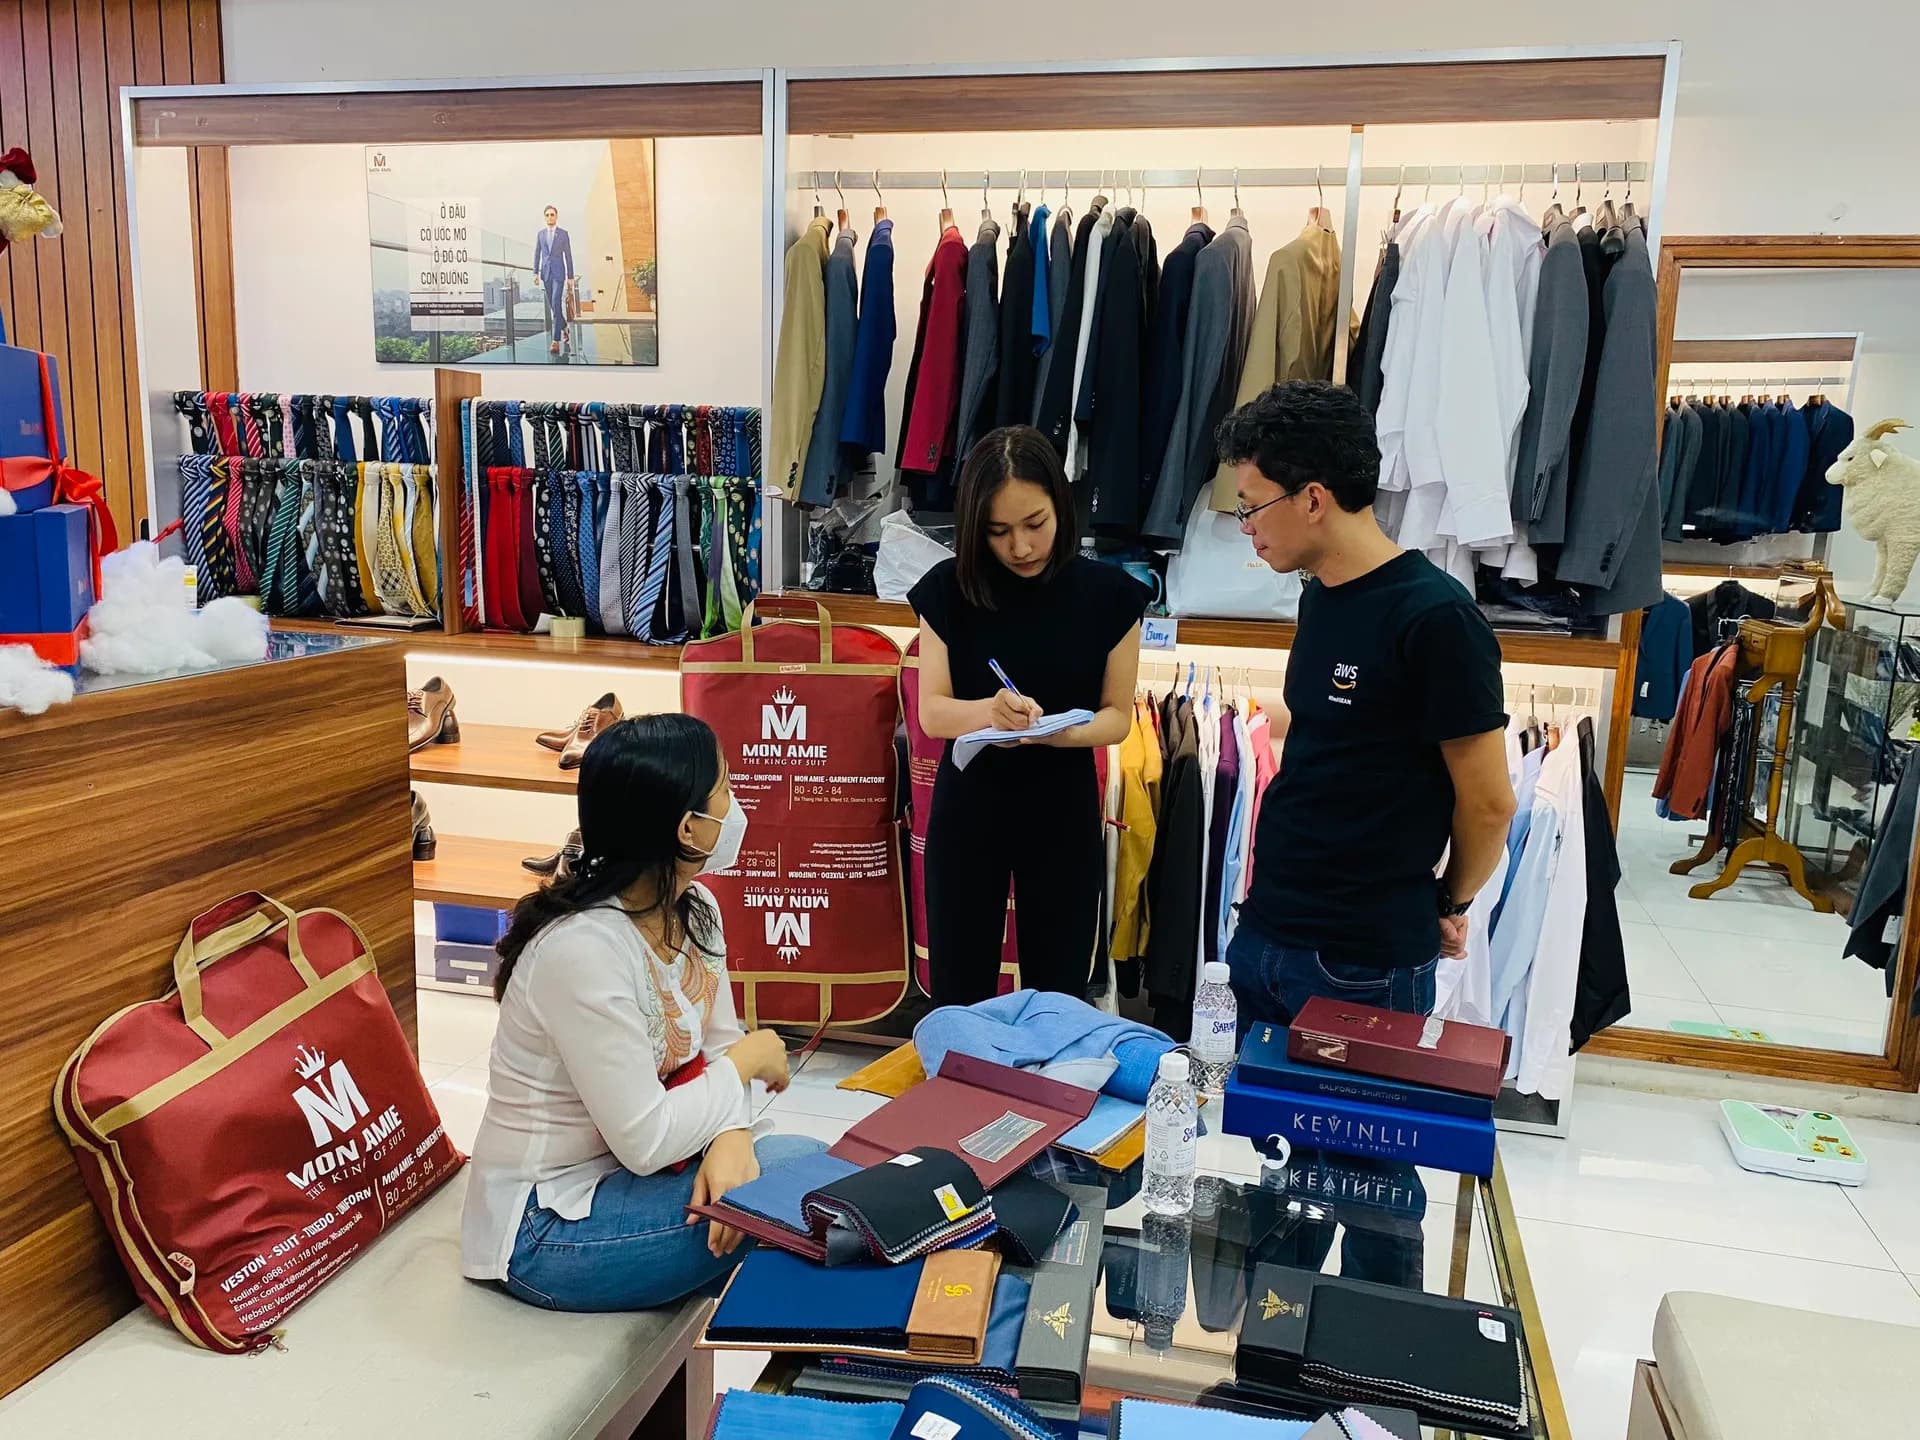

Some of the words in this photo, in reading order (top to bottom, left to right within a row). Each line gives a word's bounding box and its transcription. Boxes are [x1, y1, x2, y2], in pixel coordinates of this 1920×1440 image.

[420, 272, 438, 285] CON
[1334, 662, 1358, 680] aws
[762, 704, 807, 740] M
[742, 744, 782, 757] MON
[787, 744, 828, 758] AMIE
[764, 758, 787, 766] KING
[754, 774, 782, 782] UNIFORM
[859, 776, 886, 784] FACTORY
[794, 786, 804, 794] 80
[812, 786, 824, 794] 82
[832, 786, 842, 794] 84
[746, 858, 758, 866] 82
[765, 859, 776, 867] 80
[744, 894, 784, 908] AMIE
[790, 896, 829, 908] MON
[1293, 1112, 1417, 1148] KEVINLLI
[286, 1139, 360, 1190] MON
[362, 1104, 402, 1152] AMIE
[306, 1182, 326, 1200] THE
[373, 1145, 387, 1161] OF
[390, 1128, 406, 1150] SUIT
[399, 1153, 414, 1174] AMIE
[386, 1188, 399, 1206] 80
[406, 1172, 418, 1190] 82
[423, 1157, 434, 1175] 84
[220, 1254, 268, 1292] VESTON
[272, 1234, 300, 1256] SUIT
[229, 1282, 262, 1305] Hotline:
[233, 1296, 260, 1312] Email:
[238, 1302, 276, 1324] Website:
